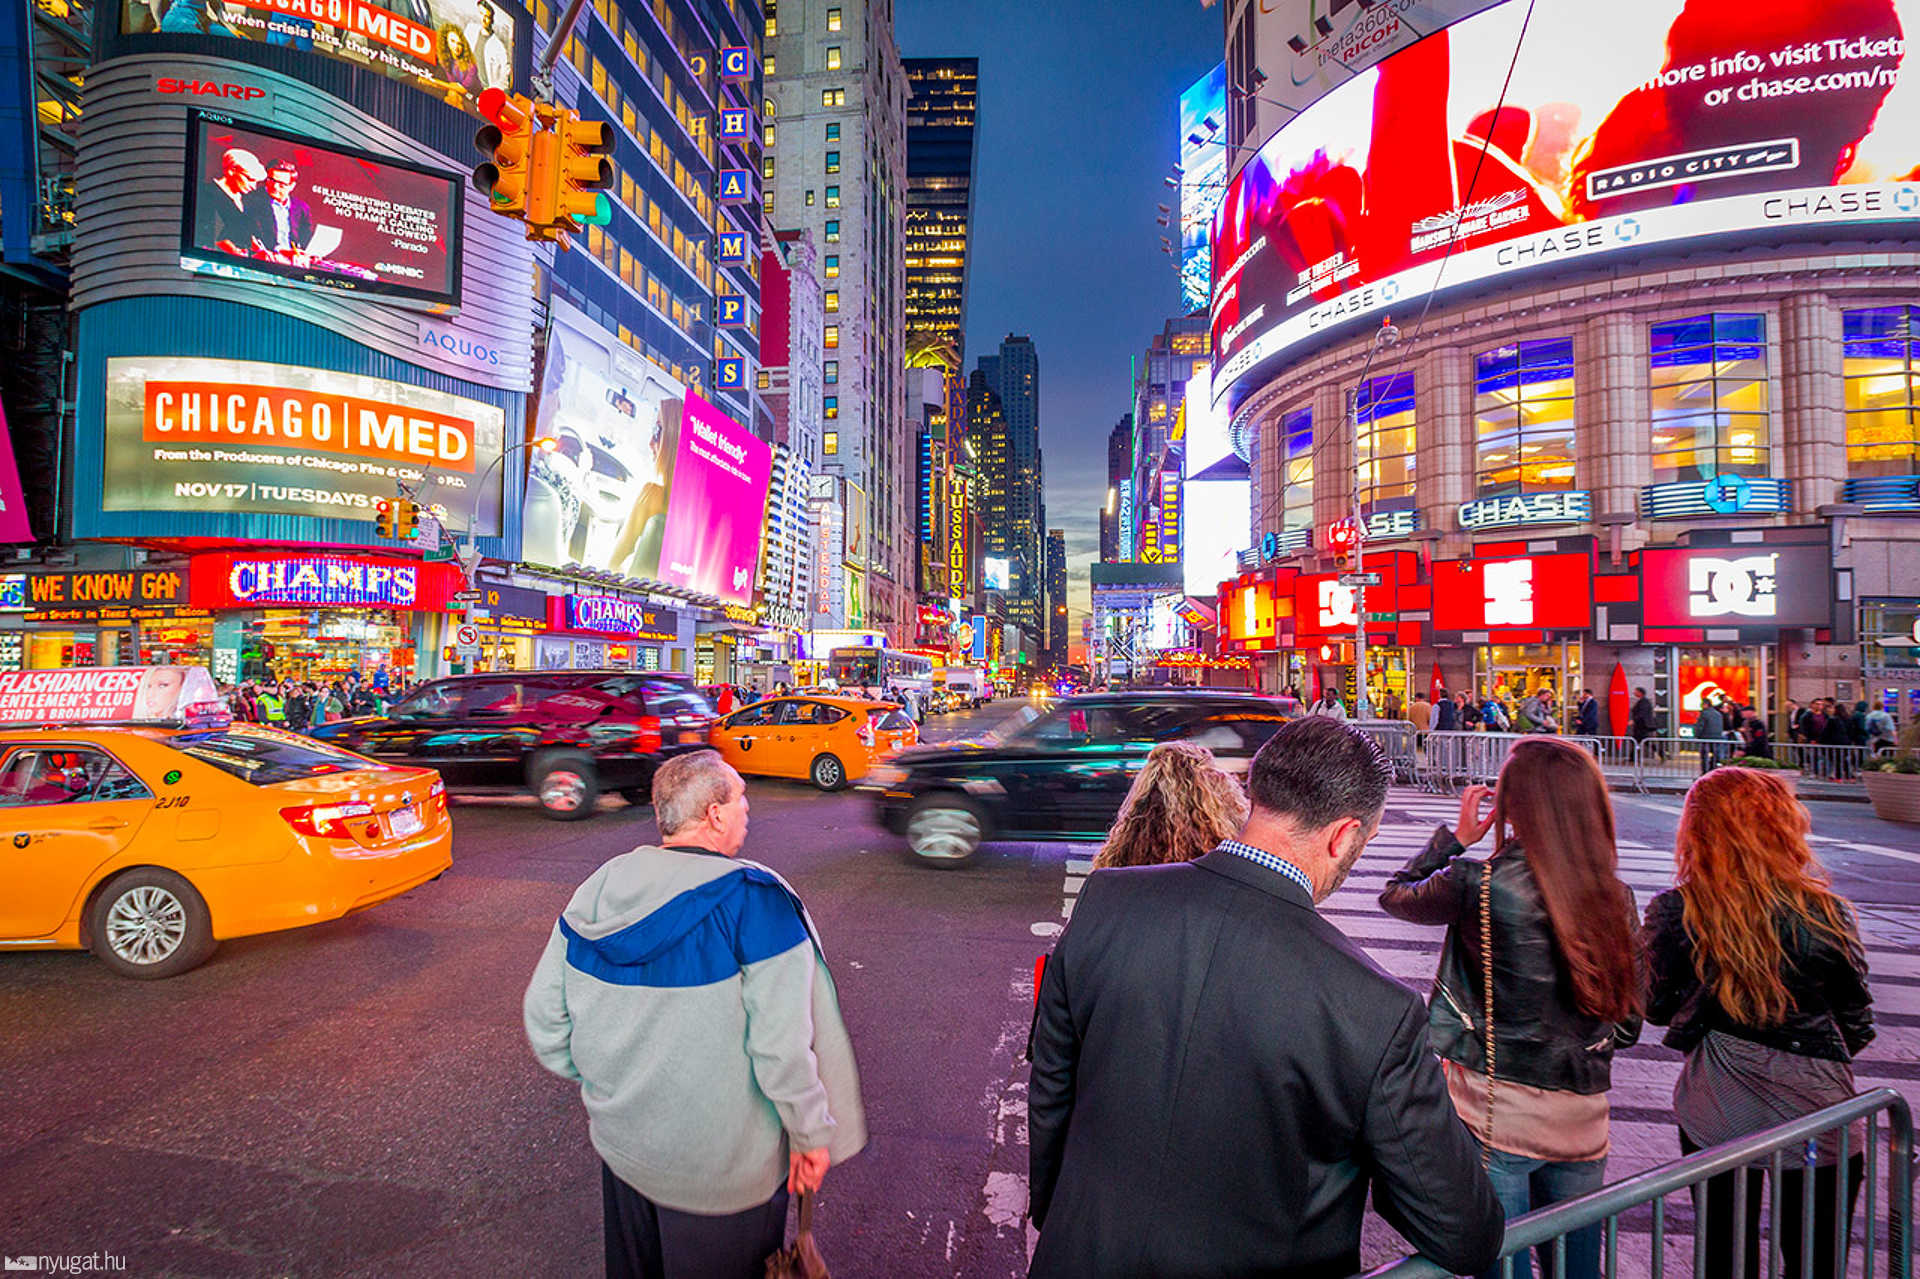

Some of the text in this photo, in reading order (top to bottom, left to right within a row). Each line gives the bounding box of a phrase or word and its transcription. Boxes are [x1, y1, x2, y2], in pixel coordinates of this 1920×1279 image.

[221, 10, 435, 83] When crisis hits, they hit back.
[358, 7, 432, 55] MED
[1343, 19, 1399, 62] RICOH
[1710, 51, 1766, 78] info,
[1768, 43, 1824, 68] visit
[157, 78, 266, 101] SHARP
[1703, 85, 1734, 107] or
[198, 110, 233, 125] AQUOS
[1596, 152, 1742, 191] RADIO CITY
[323, 196, 366, 213] ACROSS
[367, 204, 399, 220] PARTY
[335, 206, 435, 235] NO NAME CALLING
[392, 202, 436, 221] DEBATES
[722, 52, 744, 384] CHAMPS
[1763, 190, 1882, 220] CHASE
[1497, 225, 1603, 267] CHASE
[1308, 289, 1375, 330] CHASE
[424, 330, 498, 365] AQUOS
[155, 392, 468, 461] CHICAGO MED
[154, 449, 187, 461] From
[188, 449, 212, 461] the
[213, 450, 284, 465] Producers
[286, 455, 302, 466] of
[302, 455, 358, 474] Chicago
[359, 462, 385, 476] Fire
[386, 467, 398, 478] &
[175, 482, 223, 498] NOV
[223, 483, 248, 498] 17
[258, 485, 369, 508] TUESDAYS
[1457, 492, 1587, 527] CHASE
[1163, 475, 1178, 564] EW VICTORY
[819, 502, 832, 614] AMSTERDAM
[31, 575, 66, 602] WE
[72, 573, 135, 602] KNOW
[228, 562, 417, 605] CHAMPS
[579, 598, 643, 631] CHAMPS
[0, 671, 144, 693] FLASHDANCERS
[0, 692, 134, 708] ENTLEMEN'S CLUB
[0, 707, 116, 721] 52ND & BROADWAY
[155, 796, 190, 809] 2J10
